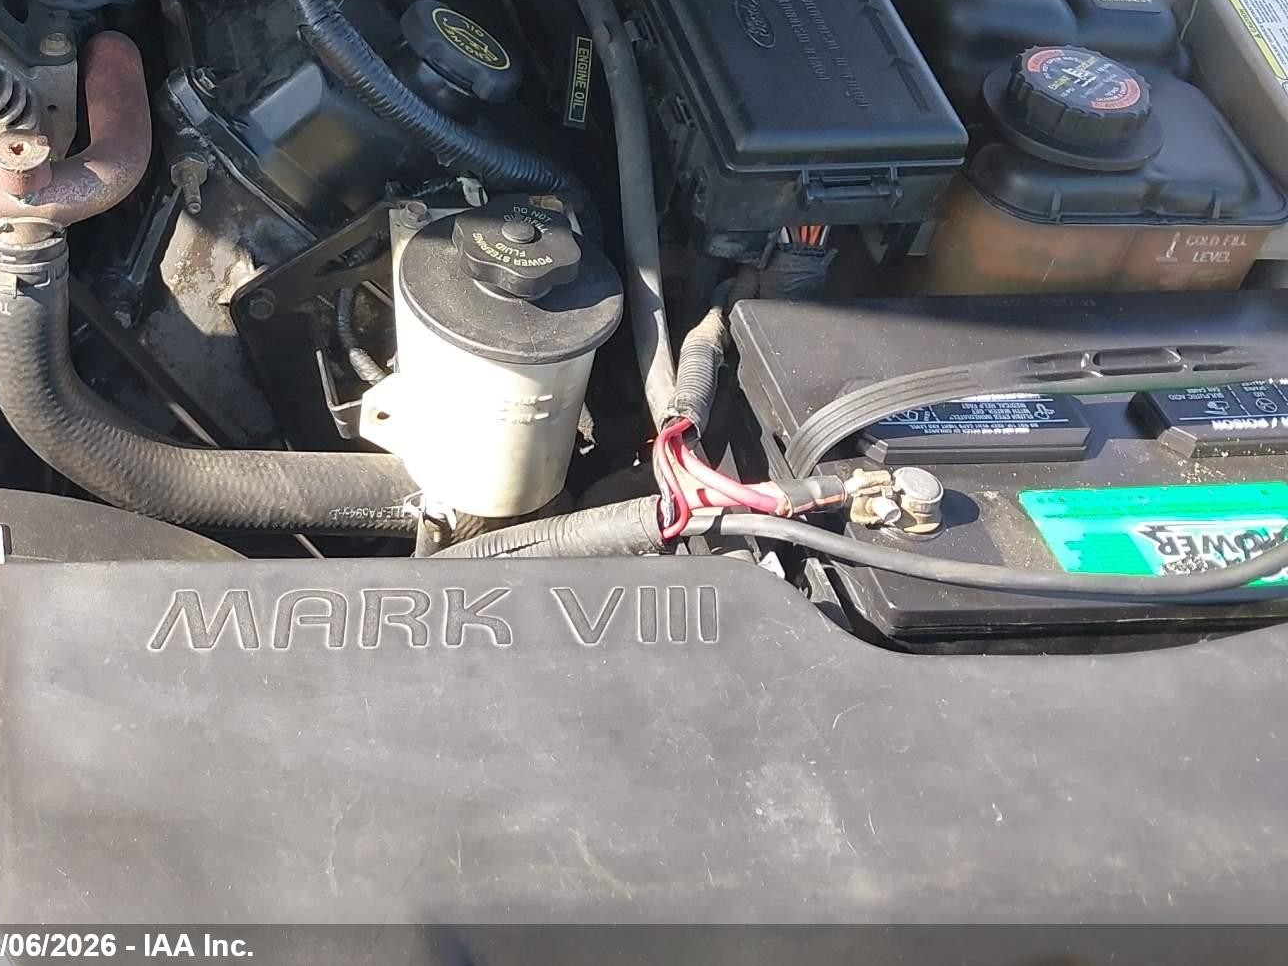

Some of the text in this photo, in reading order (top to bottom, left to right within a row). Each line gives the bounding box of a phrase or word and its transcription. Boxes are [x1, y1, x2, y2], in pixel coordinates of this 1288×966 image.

[464, 20, 485, 38] OIL
[444, 27, 492, 63] ENGINE
[572, 46, 590, 110] ENGINE OIL
[513, 206, 552, 223] DO NOT
[503, 214, 549, 234] ORFILL
[472, 232, 553, 267] POWER STEERING
[495, 242, 526, 257] FLUID
[1186, 234, 1248, 247] COLD FILL
[1192, 251, 1231, 263] LEVEL
[1211, 418, 1270, 431] POISON
[148, 586, 719, 651] MARK VIII
